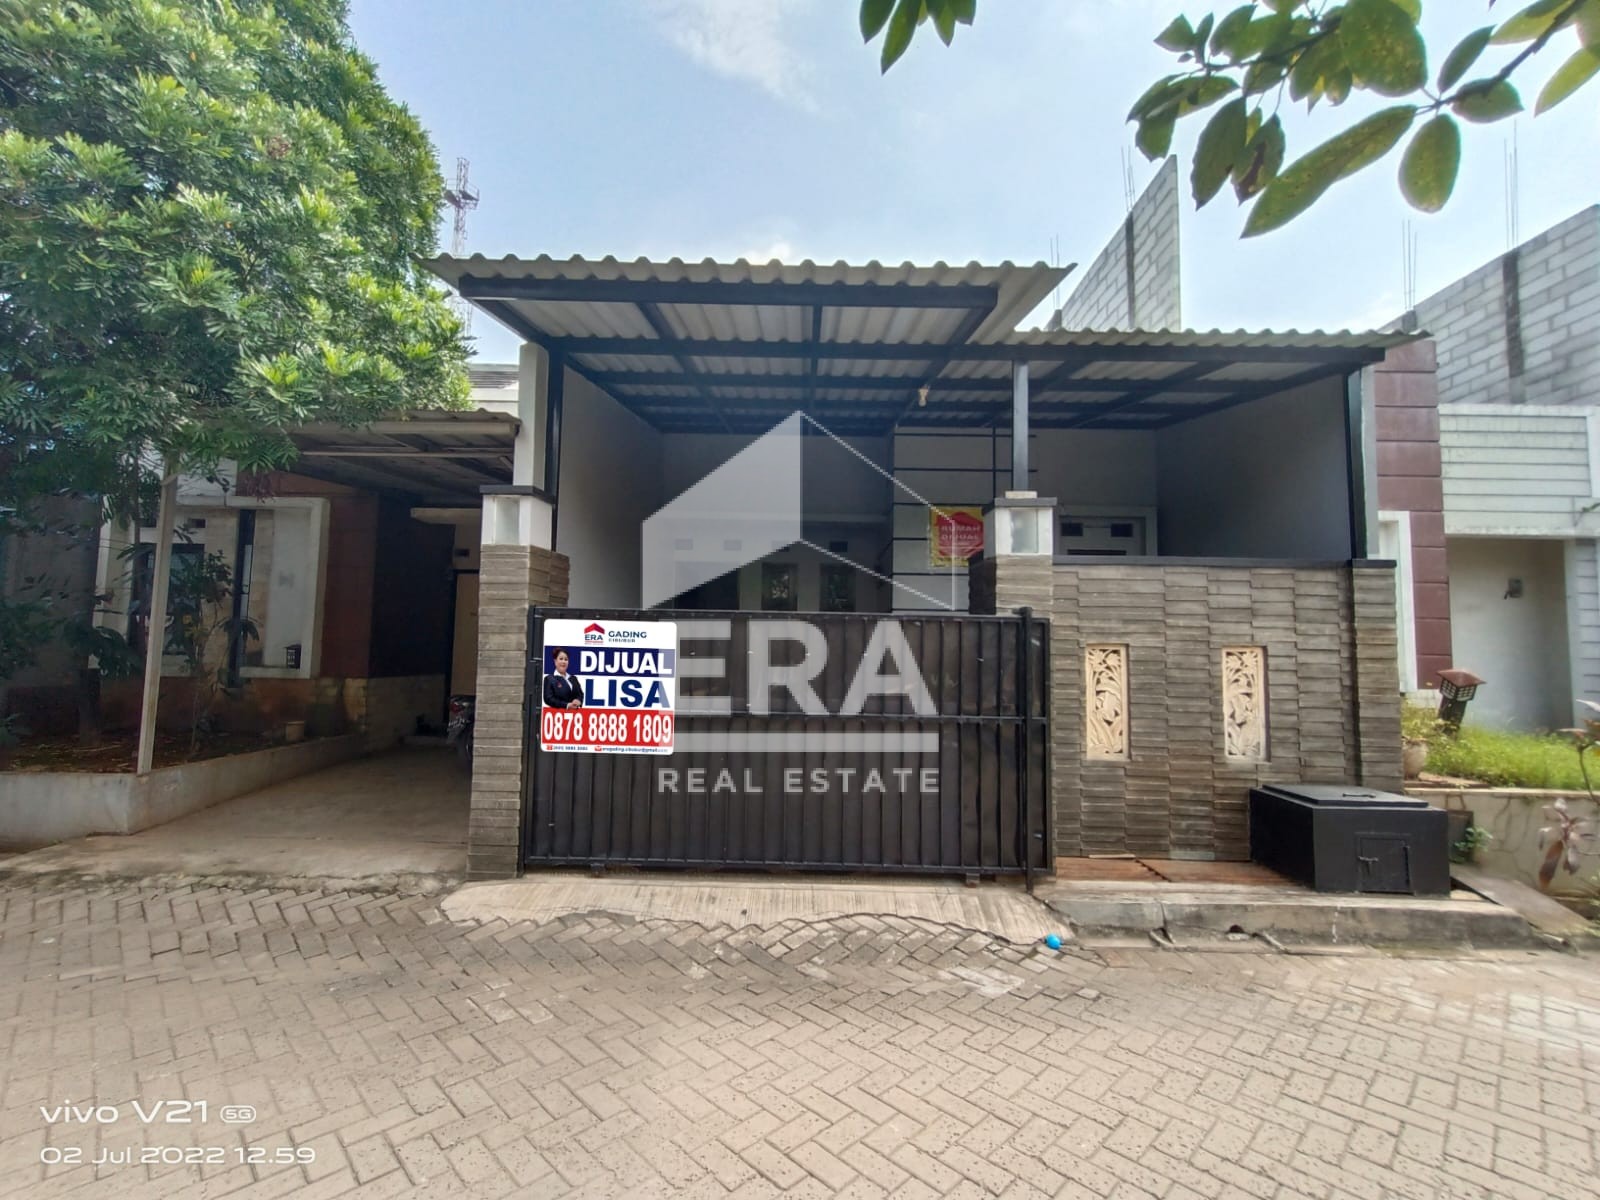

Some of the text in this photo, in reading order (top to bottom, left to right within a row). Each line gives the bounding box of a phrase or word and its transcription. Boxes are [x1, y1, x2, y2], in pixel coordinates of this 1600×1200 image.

[608, 630, 647, 638] GADING
[580, 650, 672, 674] DIJUAL
[585, 679, 670, 708] LISA
[543, 712, 672, 743] 0878 8888 1809
